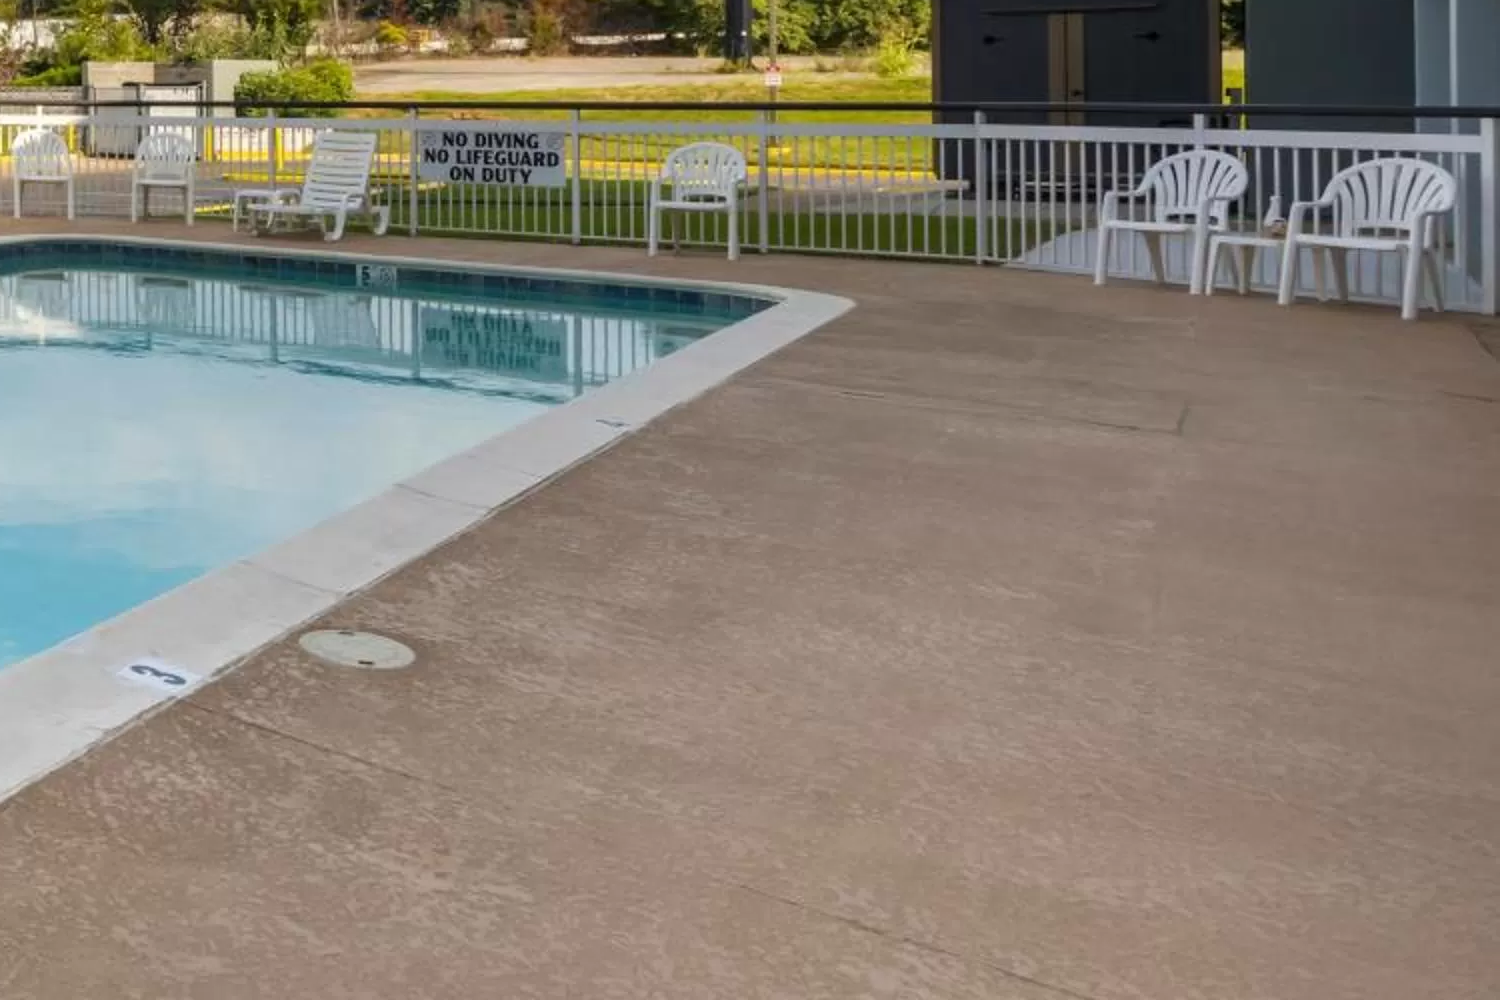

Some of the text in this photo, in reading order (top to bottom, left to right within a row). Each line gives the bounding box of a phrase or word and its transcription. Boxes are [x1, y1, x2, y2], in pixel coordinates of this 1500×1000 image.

[442, 132, 539, 149] NO DIVING
[424, 148, 560, 167] NO LIFEGUARD
[450, 166, 532, 184] ON DUTY
